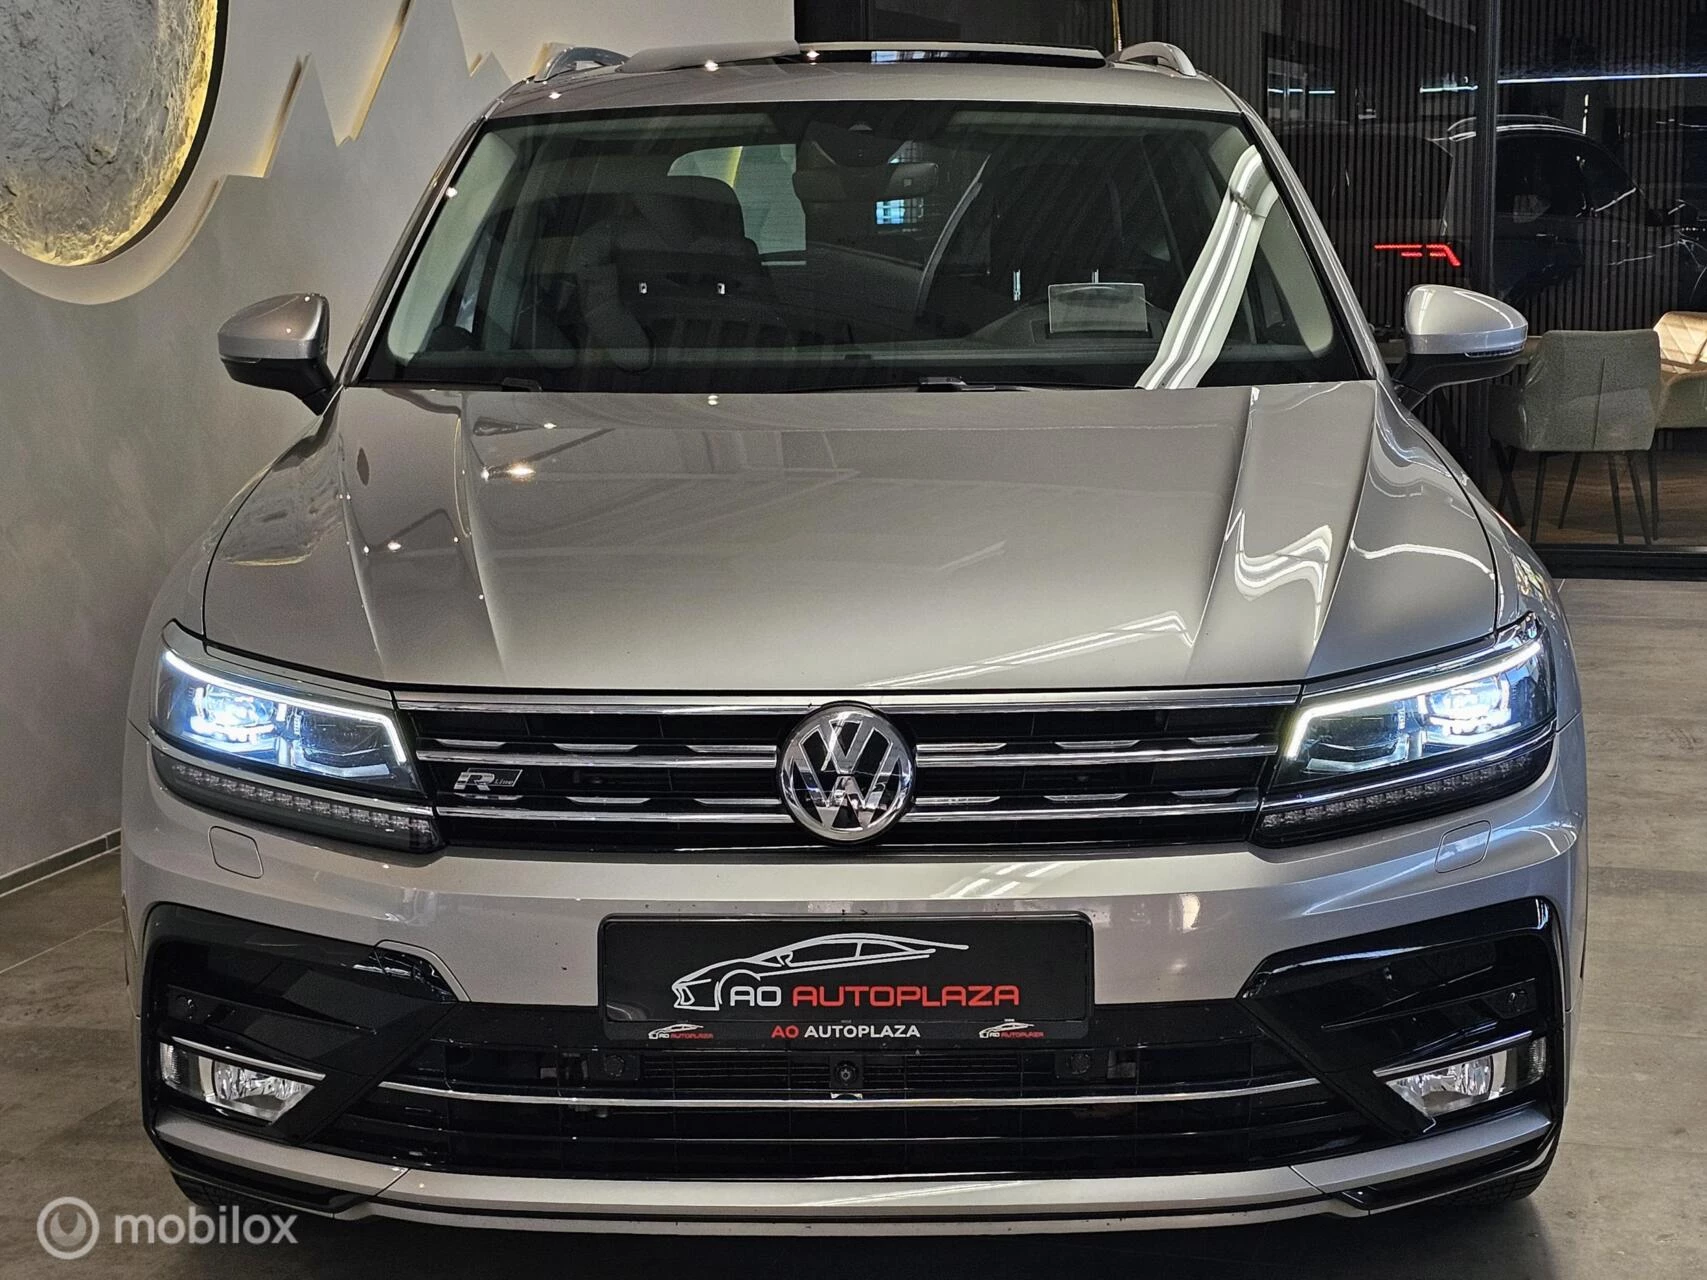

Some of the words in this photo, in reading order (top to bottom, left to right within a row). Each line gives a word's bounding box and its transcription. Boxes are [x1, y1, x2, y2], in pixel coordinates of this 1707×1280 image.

[729, 986, 782, 1007] AO
[792, 985, 1020, 1007] AUTOPLAZA
[771, 1025, 799, 1039] AO
[804, 1025, 921, 1038] AUTOPLAZA
